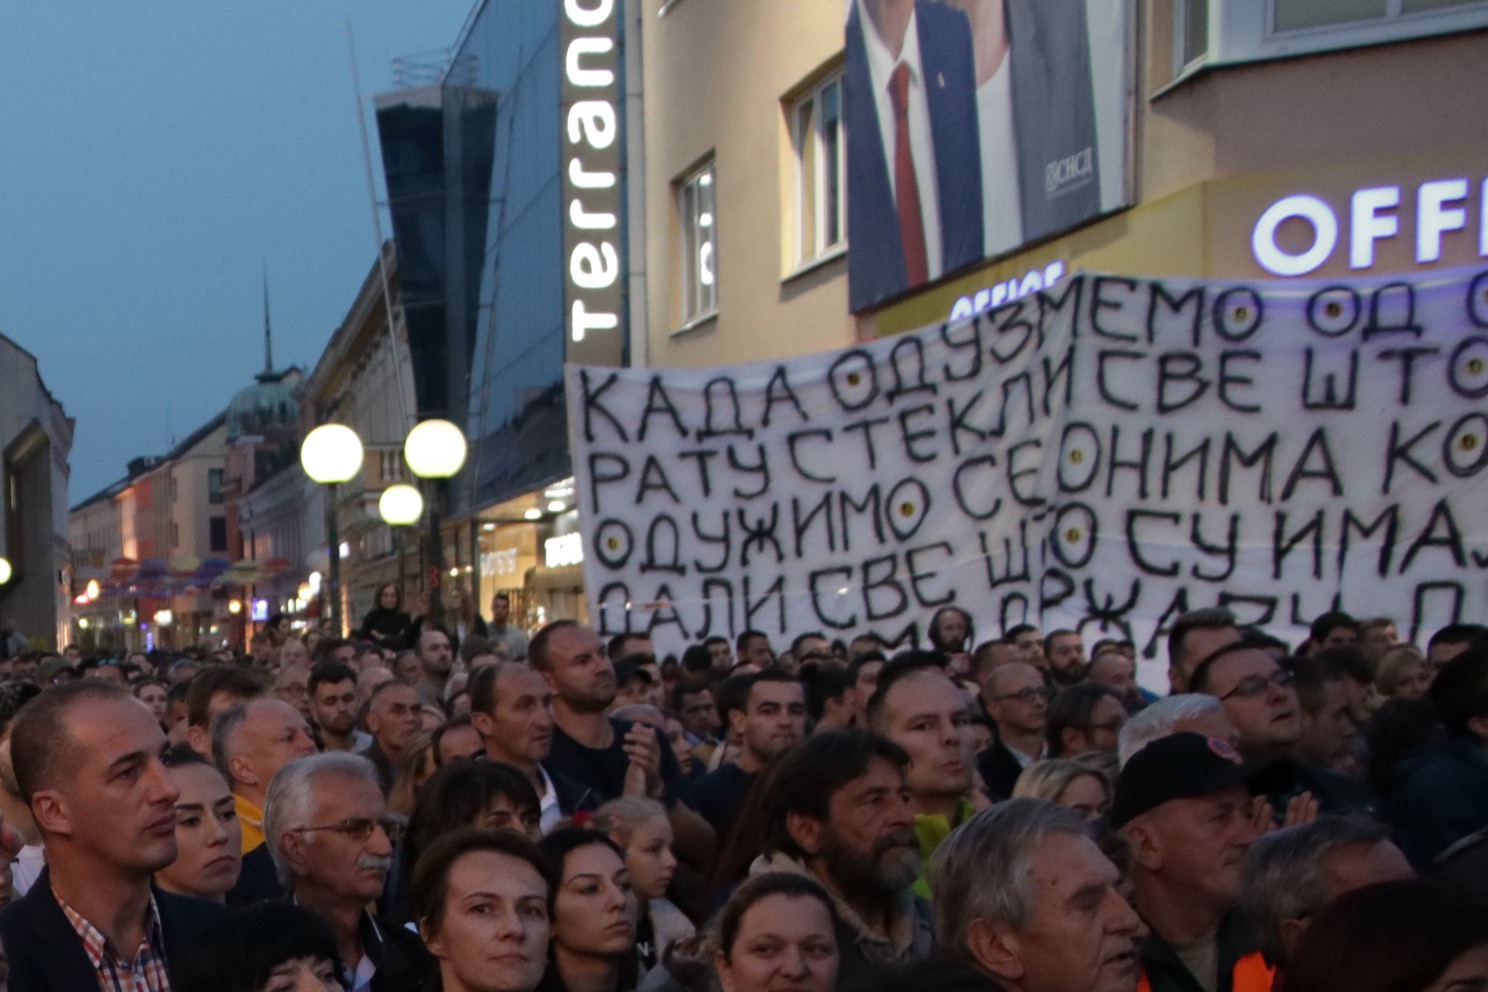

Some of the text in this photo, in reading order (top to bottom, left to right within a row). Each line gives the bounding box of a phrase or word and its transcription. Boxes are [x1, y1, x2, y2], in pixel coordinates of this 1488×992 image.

[1252, 176, 1488, 276] OFF
[580, 366, 809, 442] КАДА
[828, 273, 1264, 411] ОДУЗМЕМО
[1306, 281, 1424, 342] ОД
[588, 336, 1488, 514] РАТУ СТЕКЛИ СВЕ ШТО
[952, 440, 1048, 521] СЕ
[1057, 421, 1344, 506] ОНИМА
[810, 541, 958, 630] СВЕ
[1271, 497, 1488, 580] ИМА
